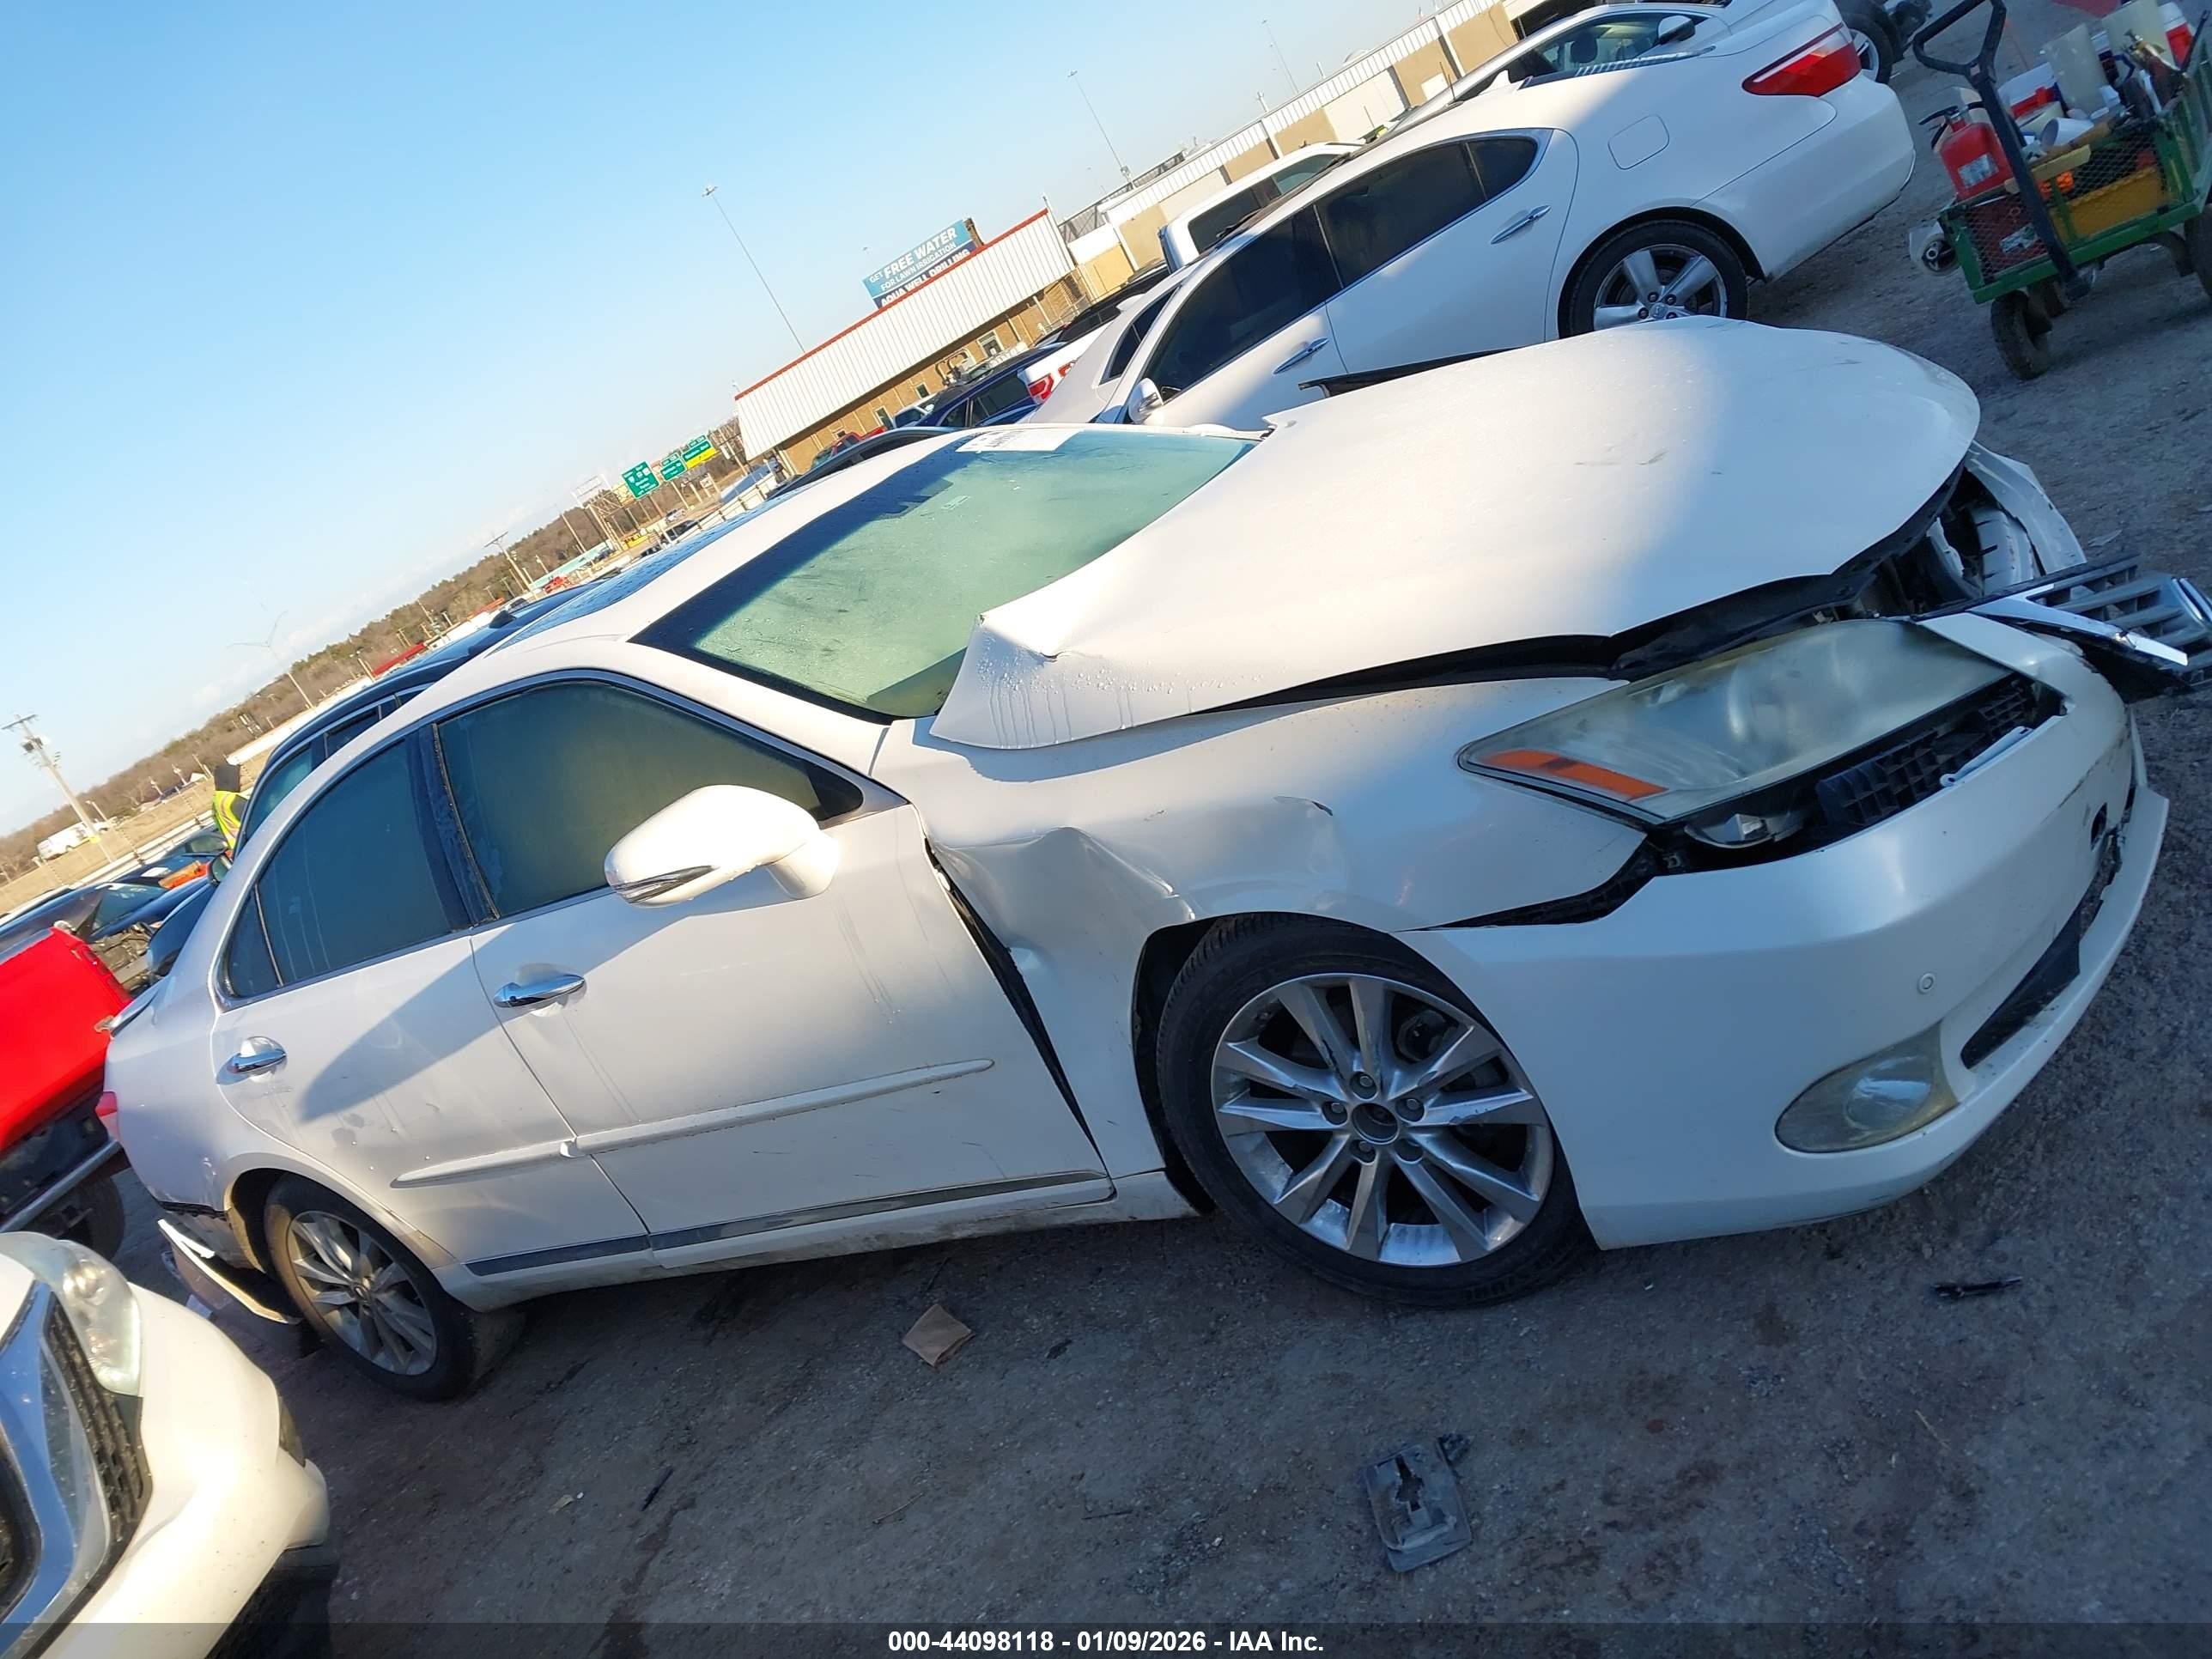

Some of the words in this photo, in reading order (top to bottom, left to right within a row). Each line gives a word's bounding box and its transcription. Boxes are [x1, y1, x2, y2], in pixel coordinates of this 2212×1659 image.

[869, 271, 884, 283] GET
[884, 252, 915, 279] FREE
[914, 227, 957, 258] WATER
[880, 278, 896, 292] FOR
[895, 265, 917, 284] LAWN
[916, 241, 957, 270] IRRIGATION
[904, 271, 930, 292] WELL
